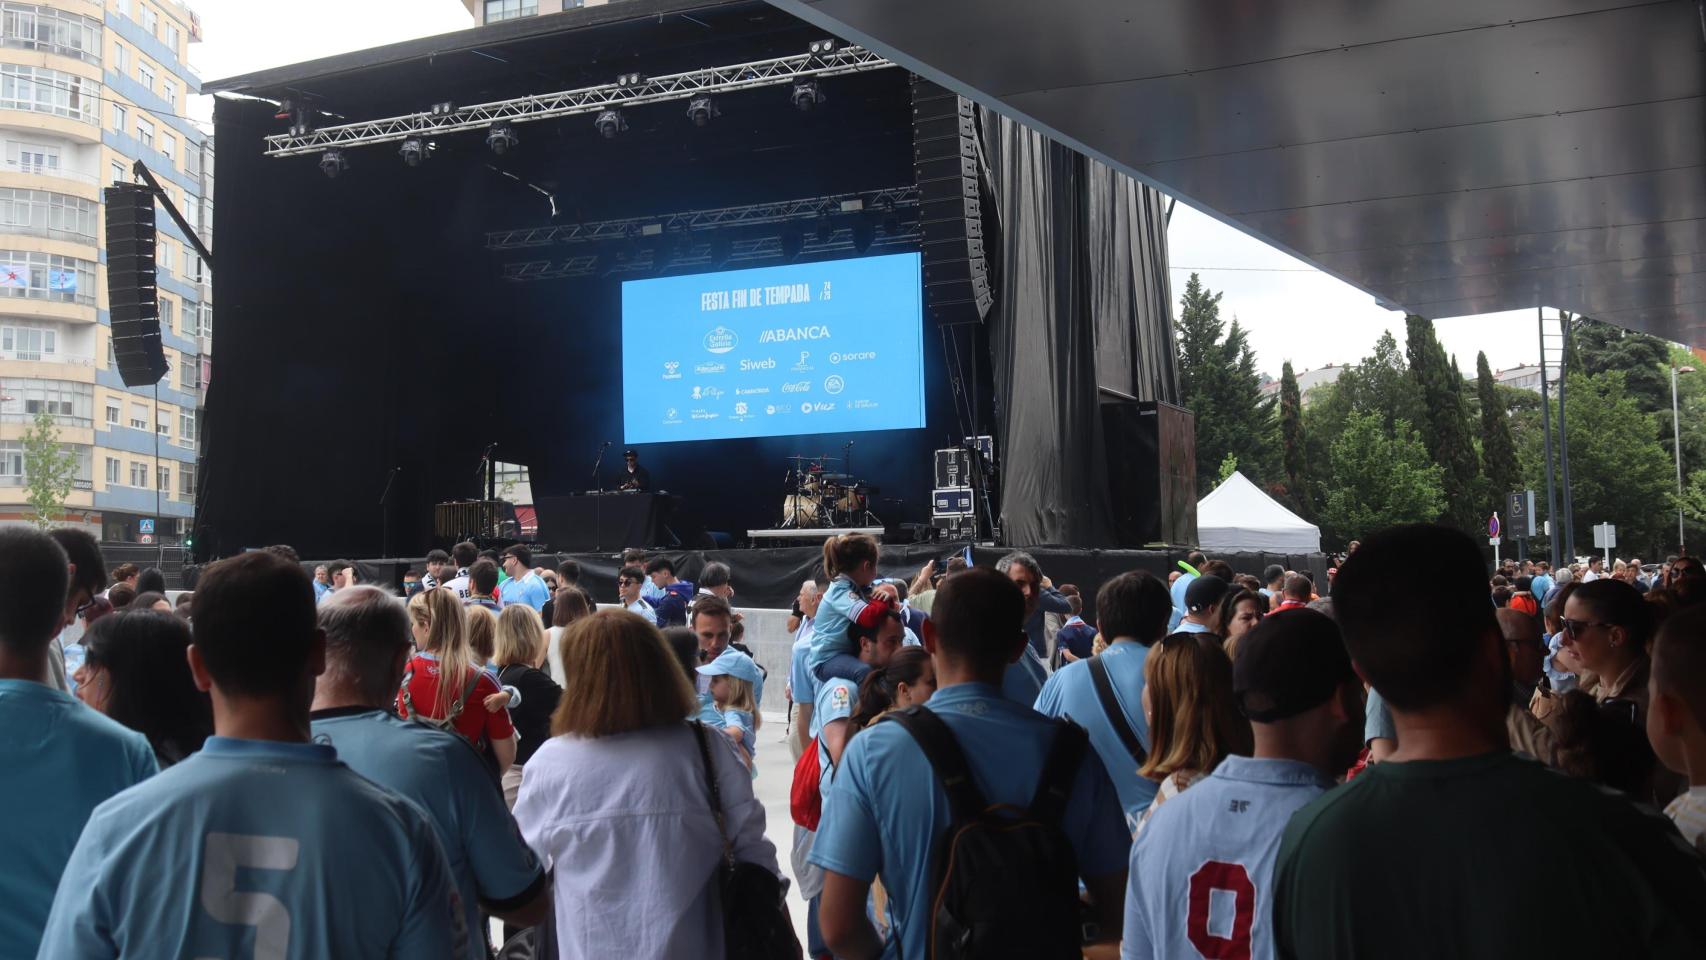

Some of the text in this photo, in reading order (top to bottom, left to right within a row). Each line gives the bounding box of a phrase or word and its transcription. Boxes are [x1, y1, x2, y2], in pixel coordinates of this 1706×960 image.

[701, 283, 810, 311] FESTA FIN DE TEMPADA
[740, 357, 776, 371] Siweb
[843, 351, 876, 361] sorare
[201, 832, 299, 960] 5
